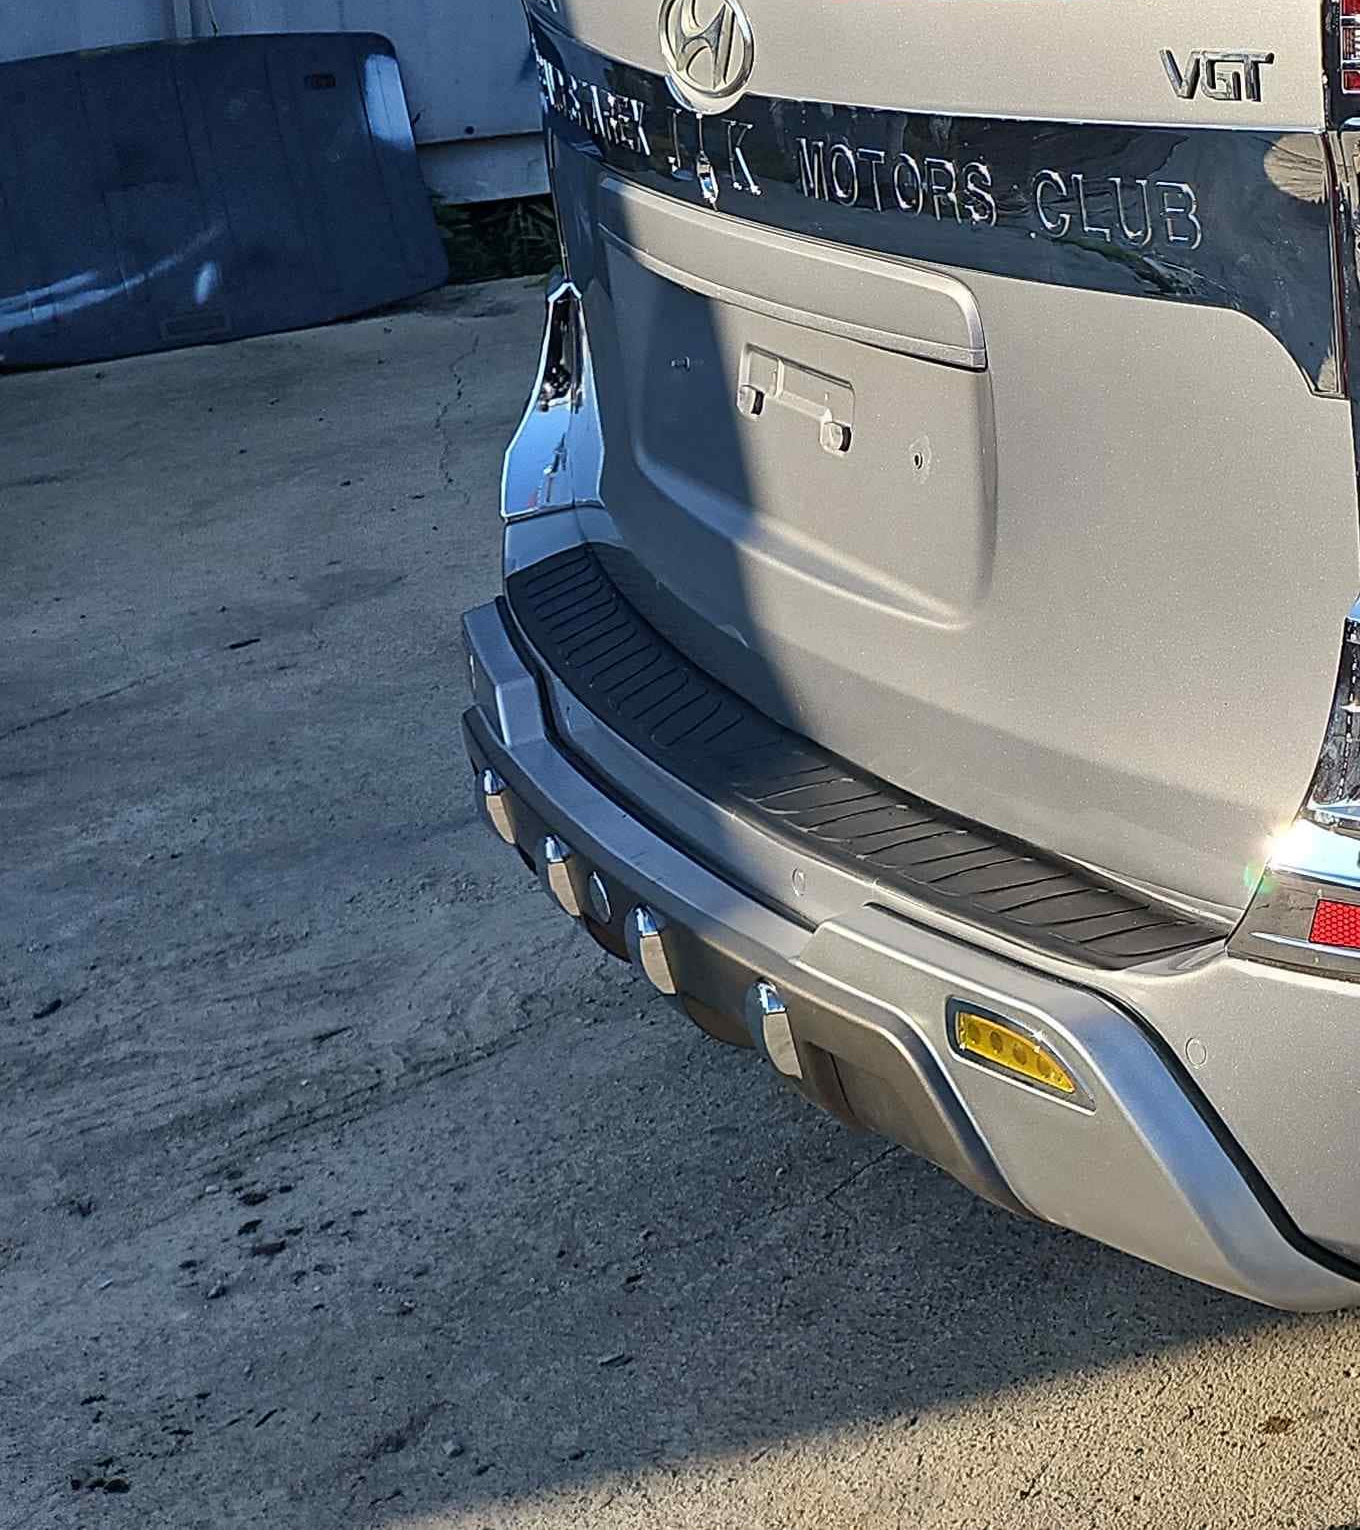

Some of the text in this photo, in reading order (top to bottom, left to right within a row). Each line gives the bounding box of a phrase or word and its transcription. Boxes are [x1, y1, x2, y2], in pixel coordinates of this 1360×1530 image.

[1159, 48, 1275, 103] VGT
[797, 137, 998, 228] MOTORS
[1032, 168, 1203, 251] CLUB
